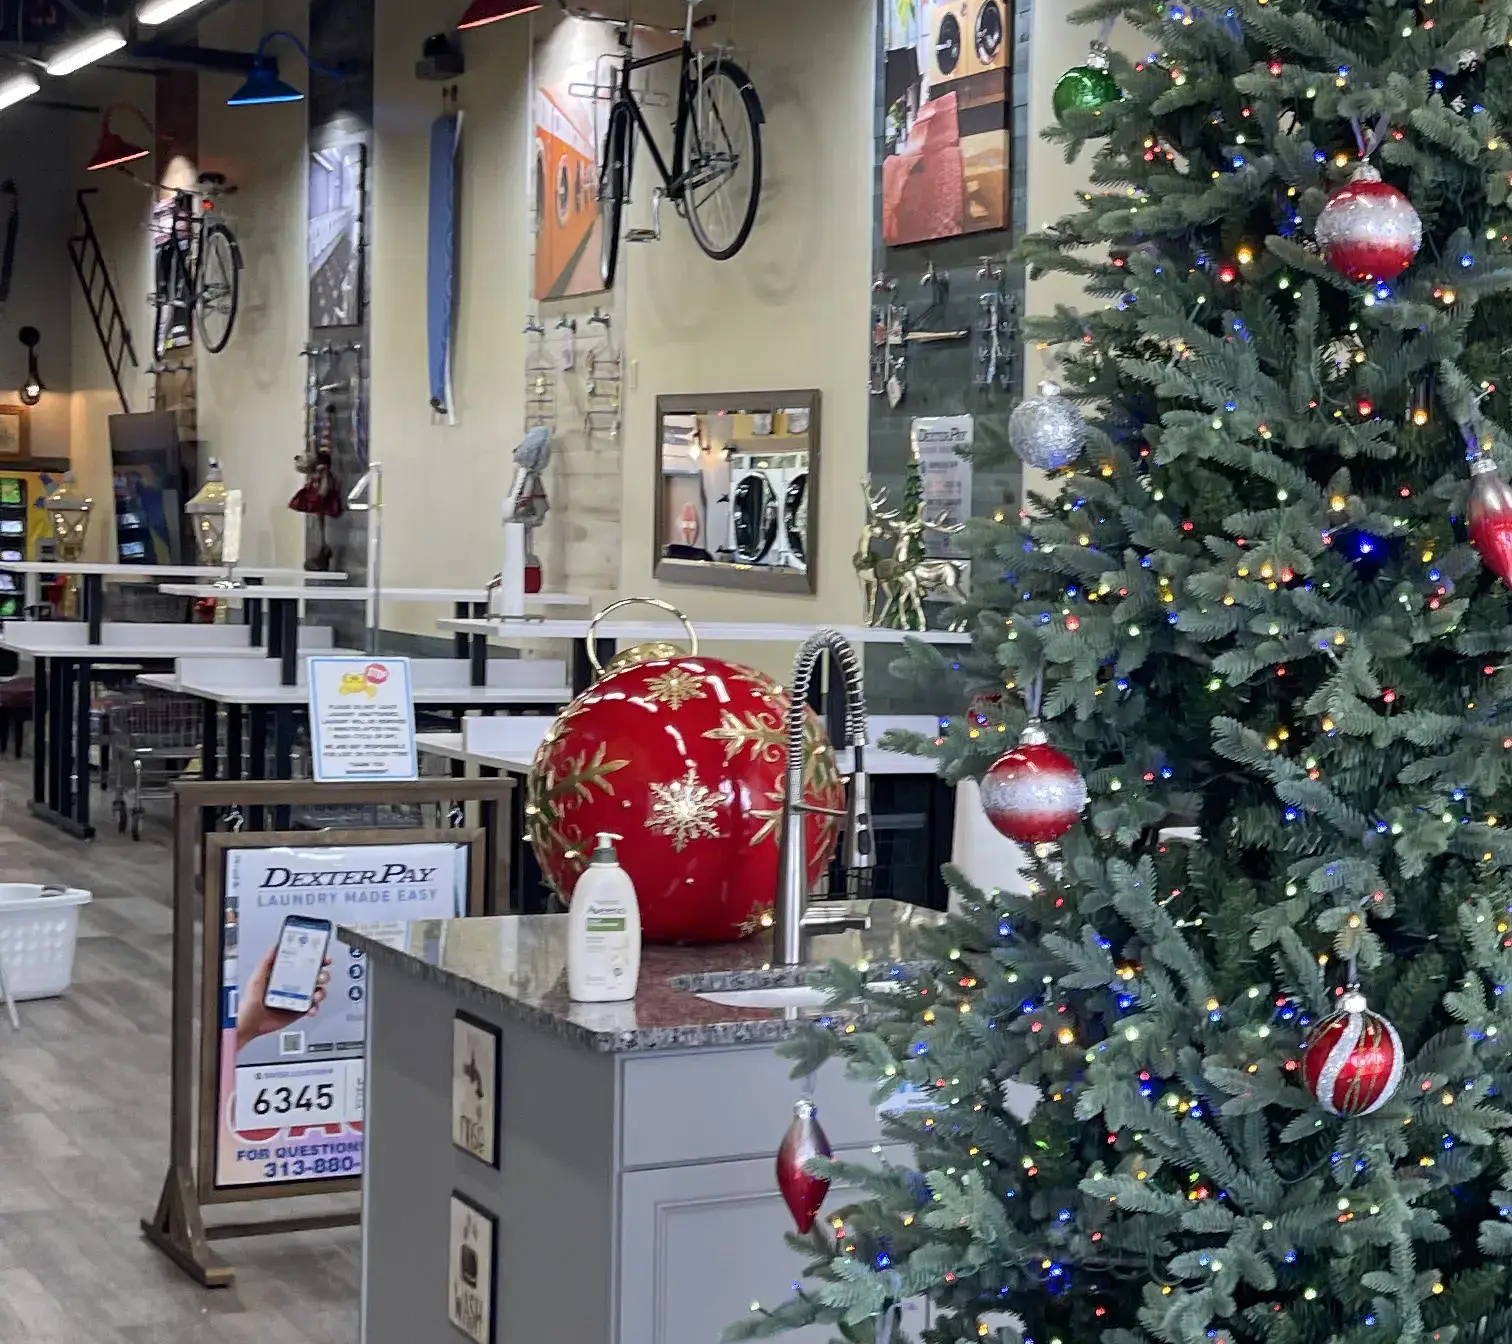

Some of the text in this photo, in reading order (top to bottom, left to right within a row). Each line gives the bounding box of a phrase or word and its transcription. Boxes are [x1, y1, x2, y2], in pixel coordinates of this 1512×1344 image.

[257, 888, 438, 907] LAUNDRY MADE EASY
[254, 1083, 334, 1115] 6345
[236, 1148, 270, 1161] FOR
